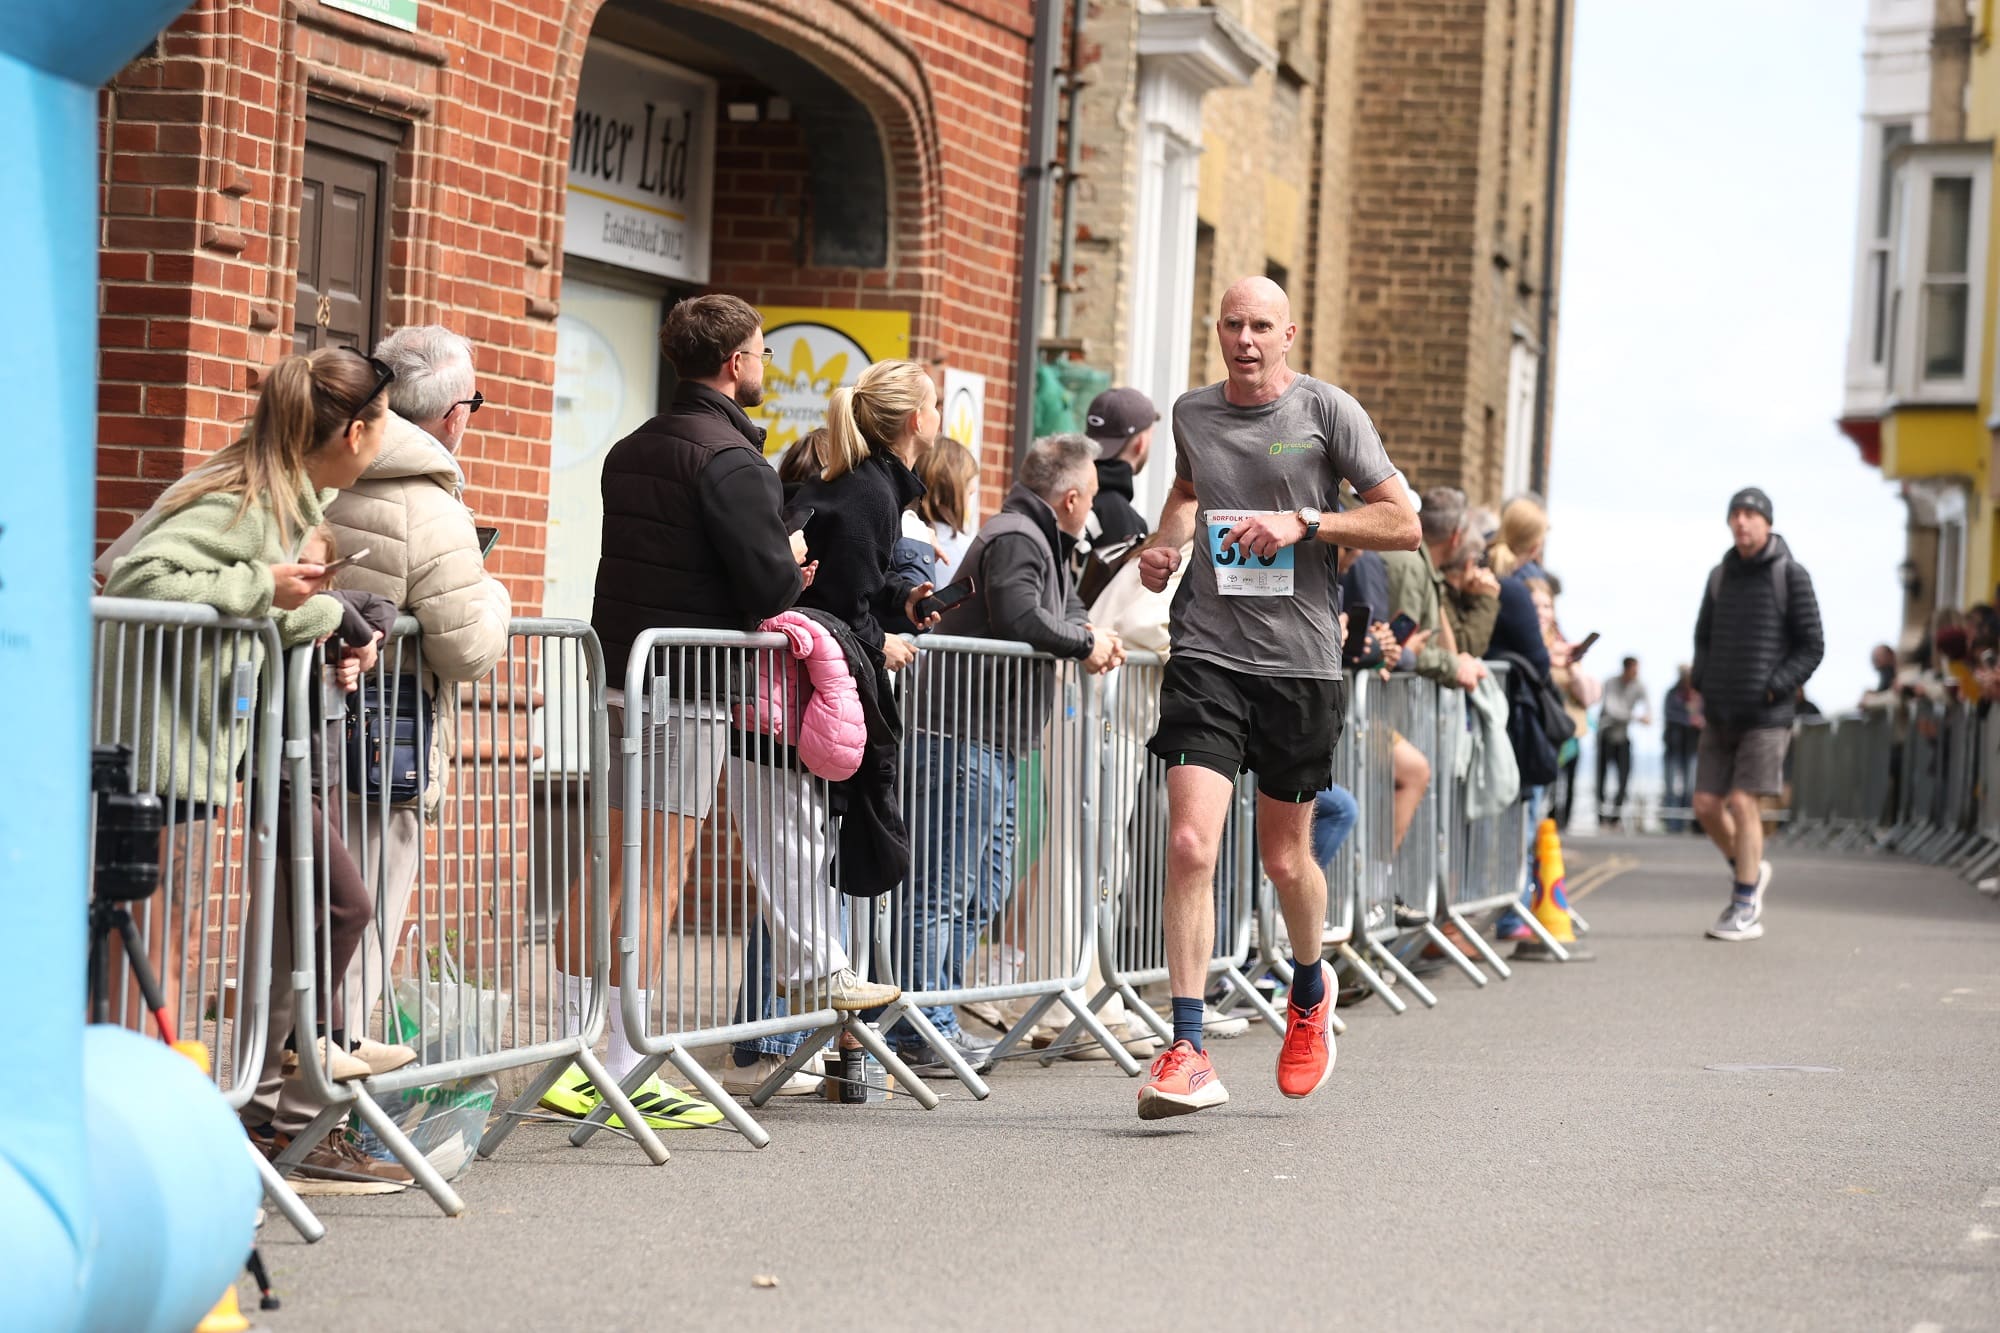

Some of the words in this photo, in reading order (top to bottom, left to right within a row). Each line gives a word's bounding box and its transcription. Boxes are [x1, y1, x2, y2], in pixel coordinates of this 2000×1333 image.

[637, 103, 693, 202] Ltd
[602, 211, 660, 254] Established
[761, 401, 825, 421] Crome
